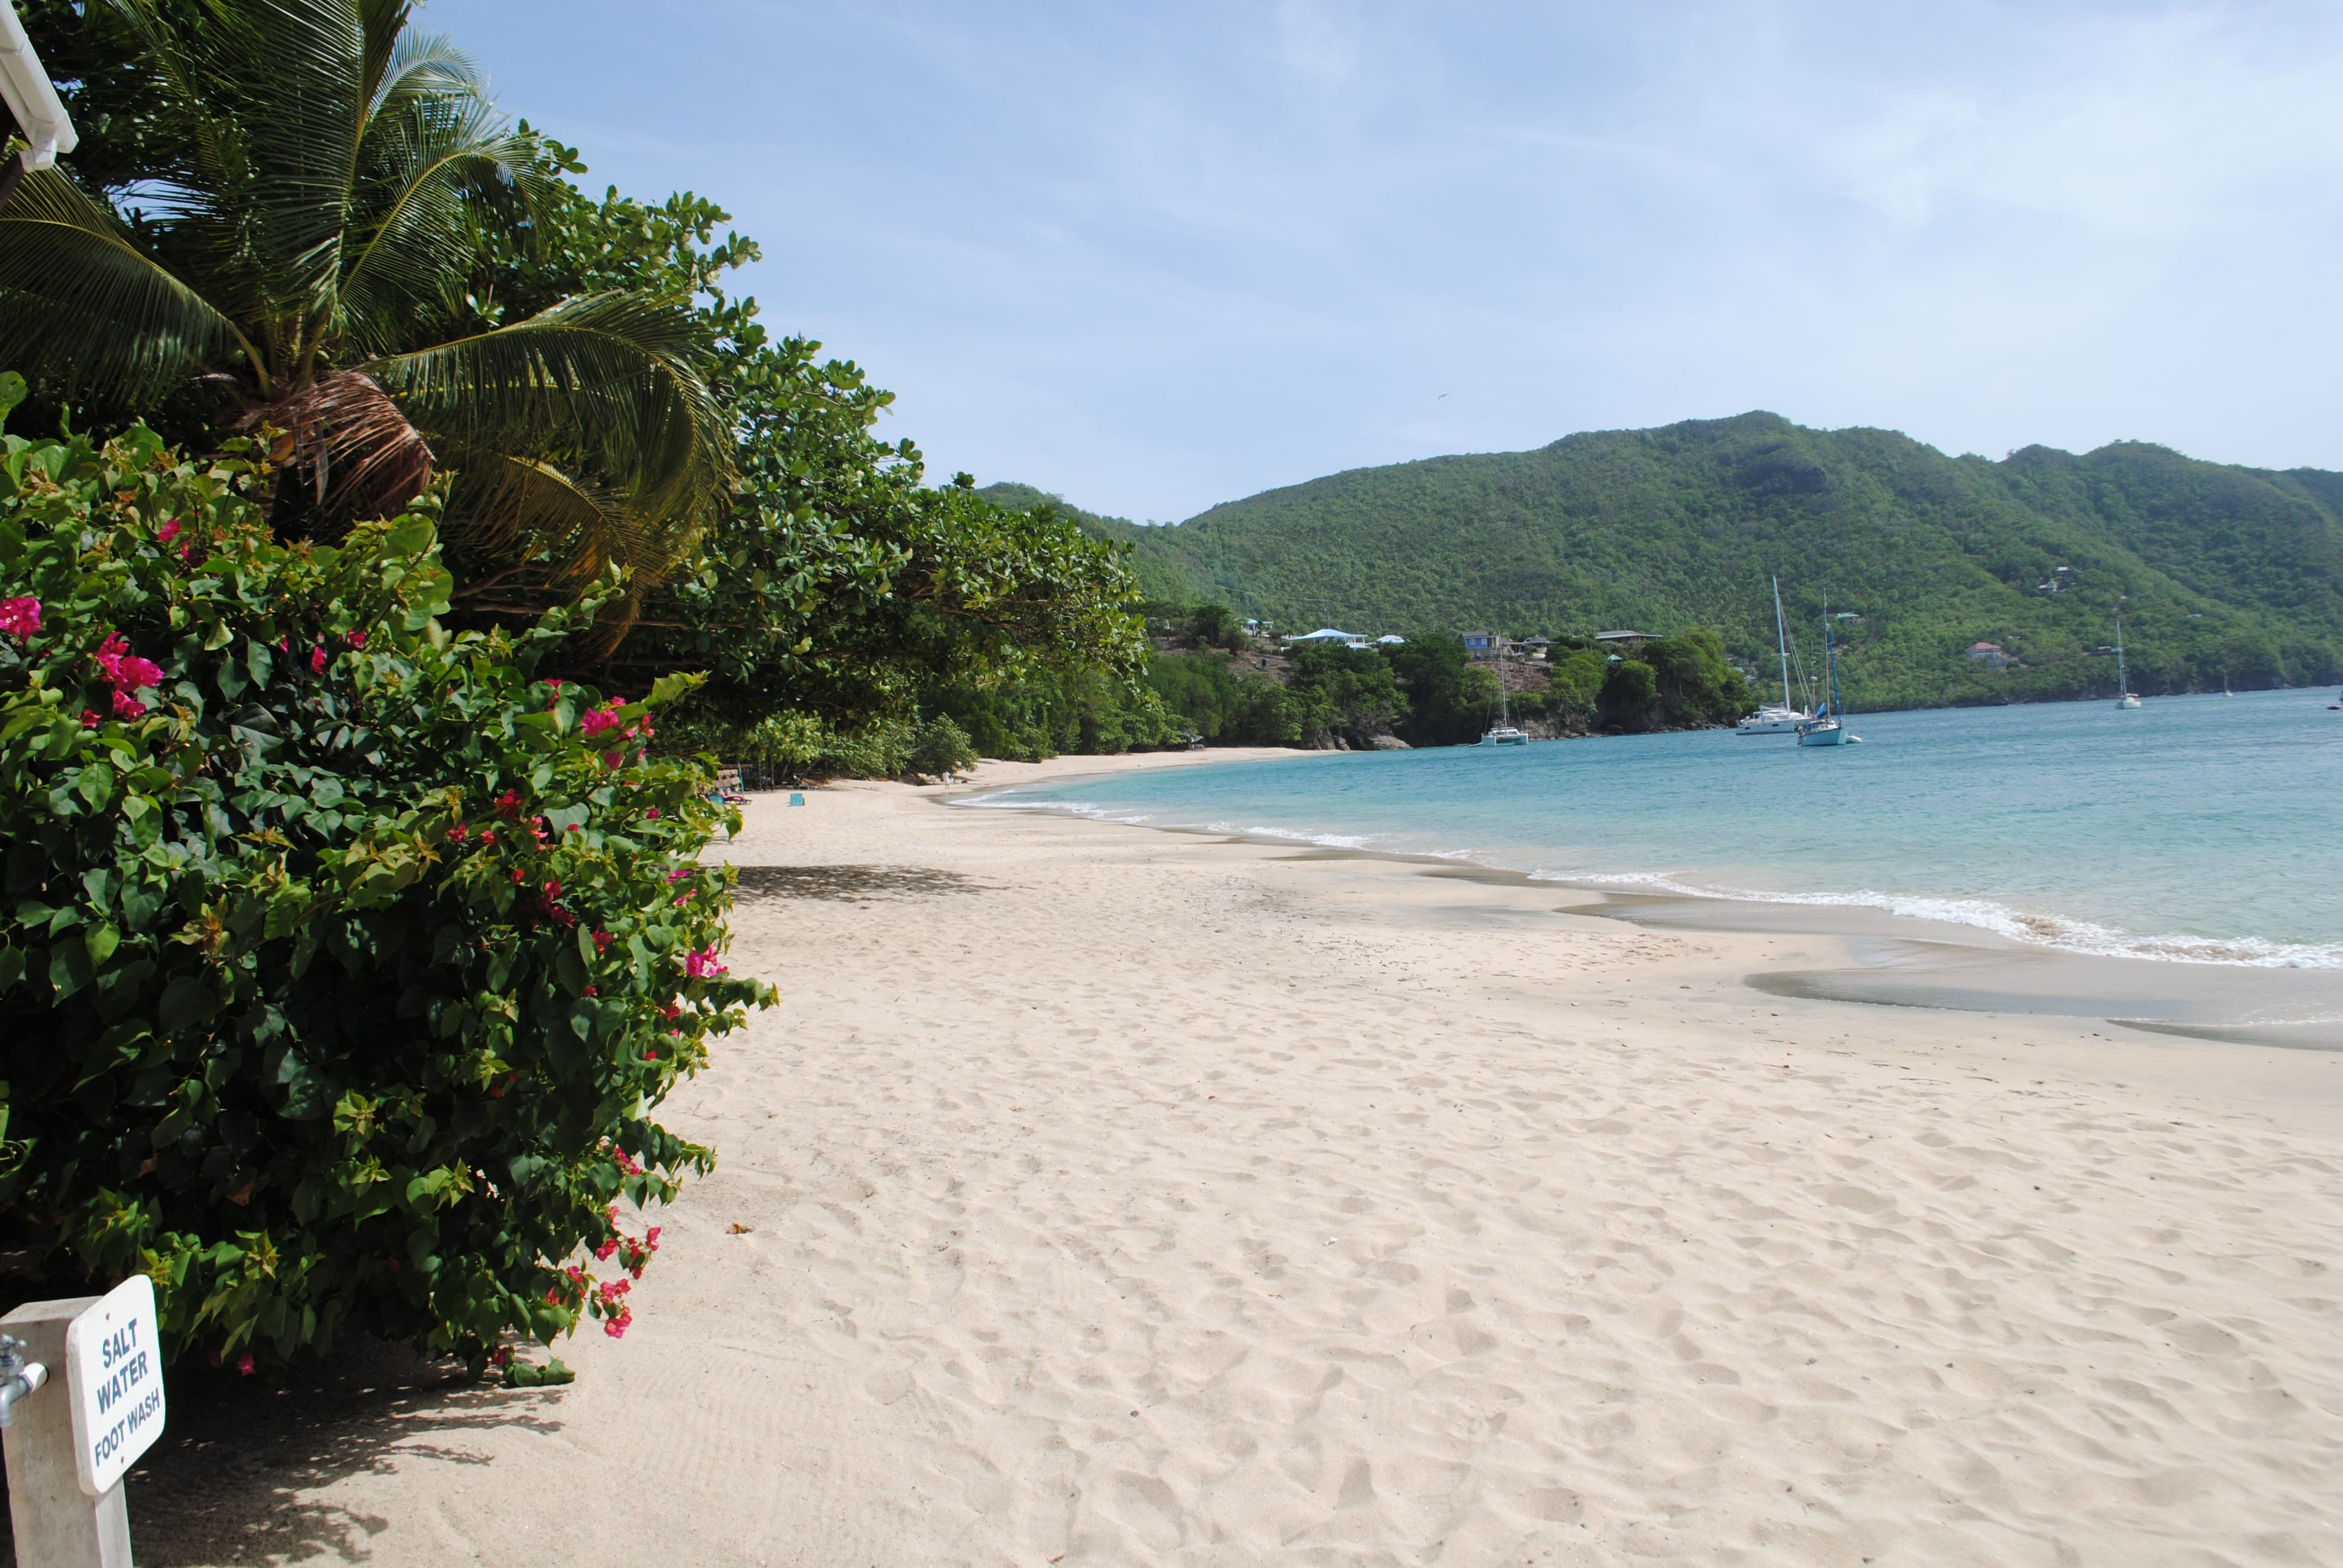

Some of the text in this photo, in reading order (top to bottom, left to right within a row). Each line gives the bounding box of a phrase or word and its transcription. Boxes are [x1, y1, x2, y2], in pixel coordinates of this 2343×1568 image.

[102, 1318, 137, 1368] SALT
[97, 1350, 148, 1415] WATER
[95, 1388, 160, 1467] FOOT WASH
